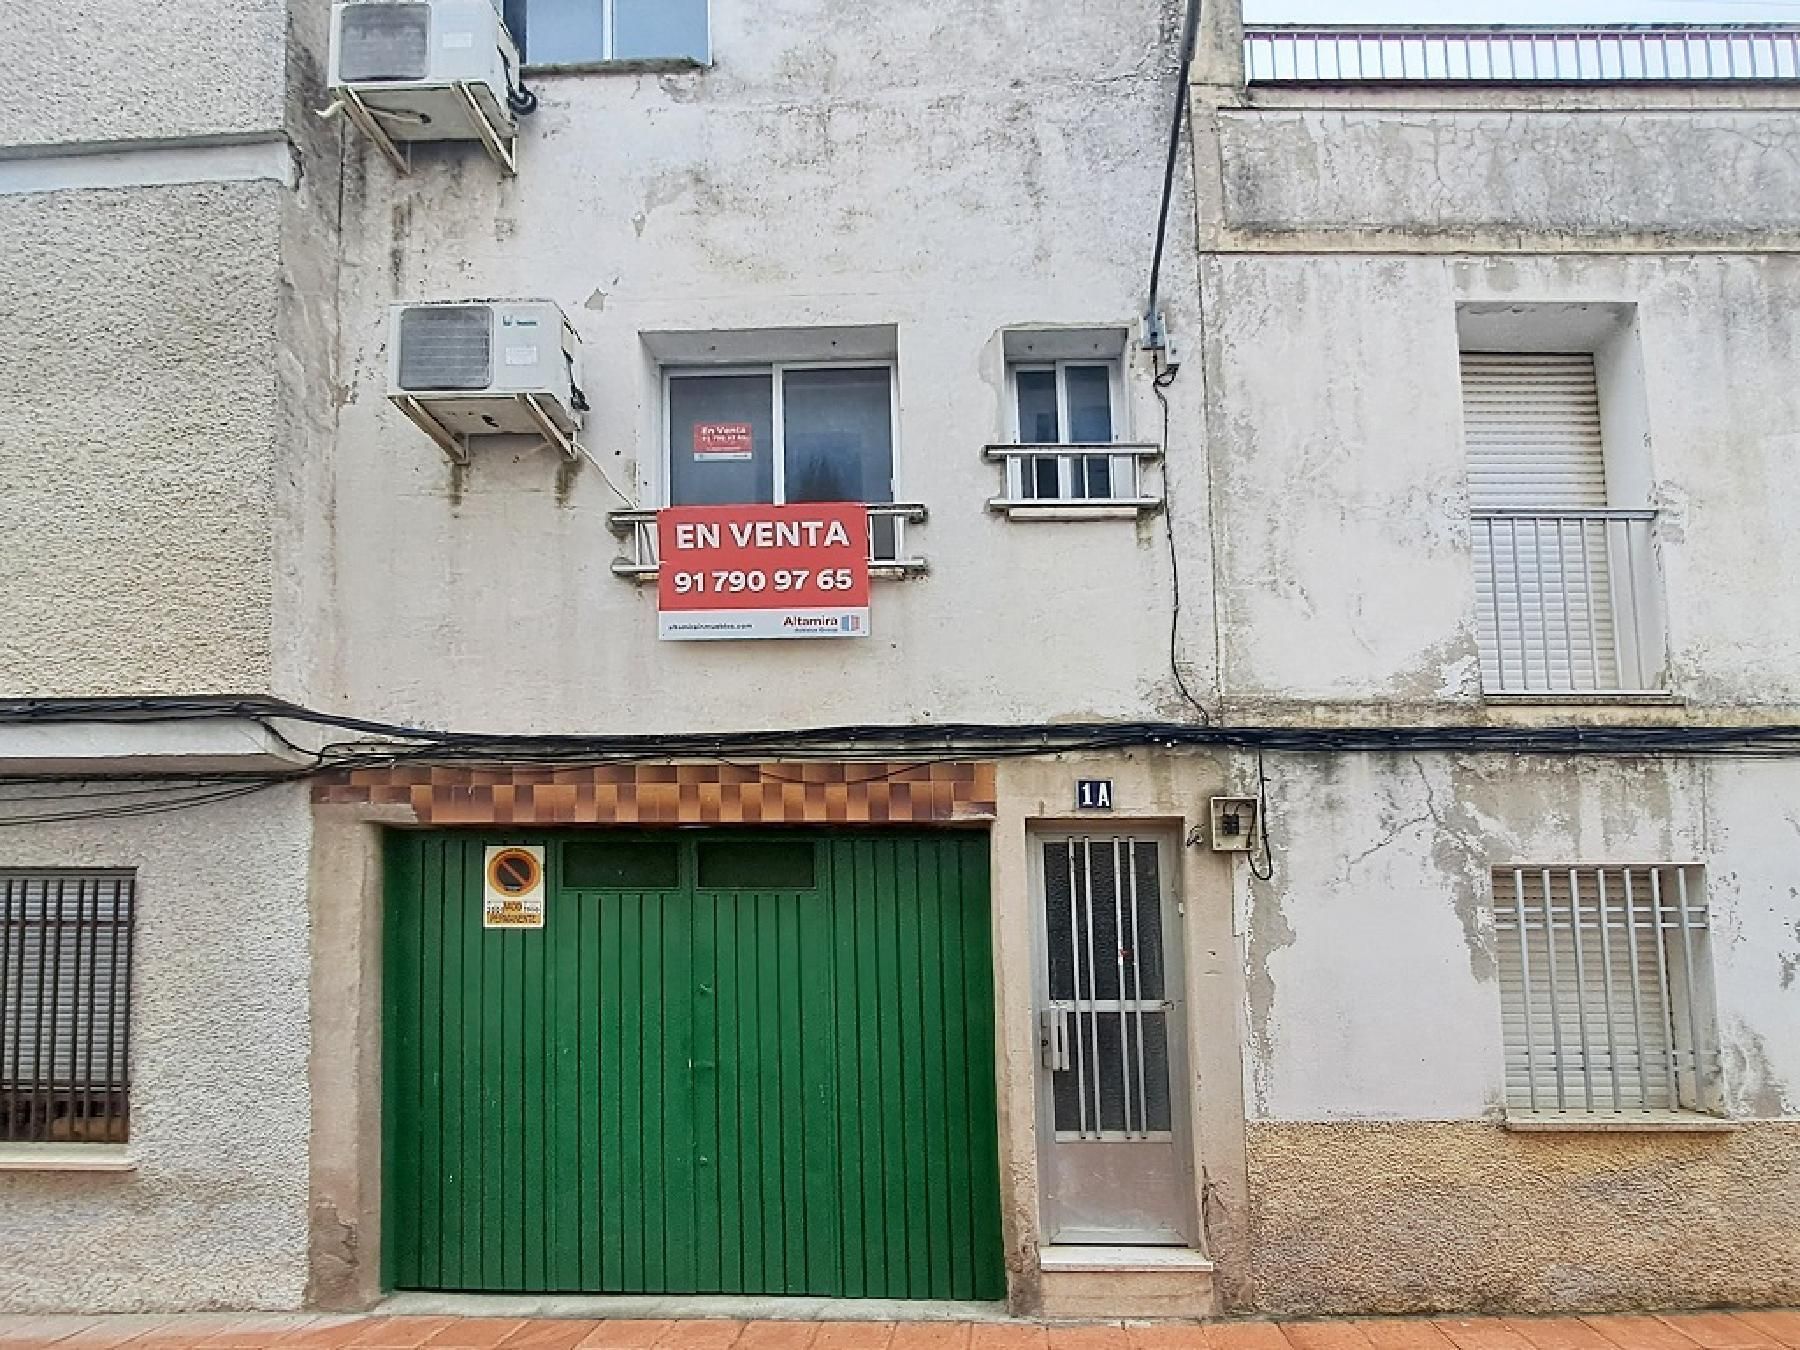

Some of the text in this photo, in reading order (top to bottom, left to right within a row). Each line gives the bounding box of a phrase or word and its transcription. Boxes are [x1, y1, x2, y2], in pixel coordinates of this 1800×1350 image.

[676, 520, 850, 549] EN VENTA
[674, 568, 853, 593] 91 790 97 65
[783, 615, 838, 627] Altamira
